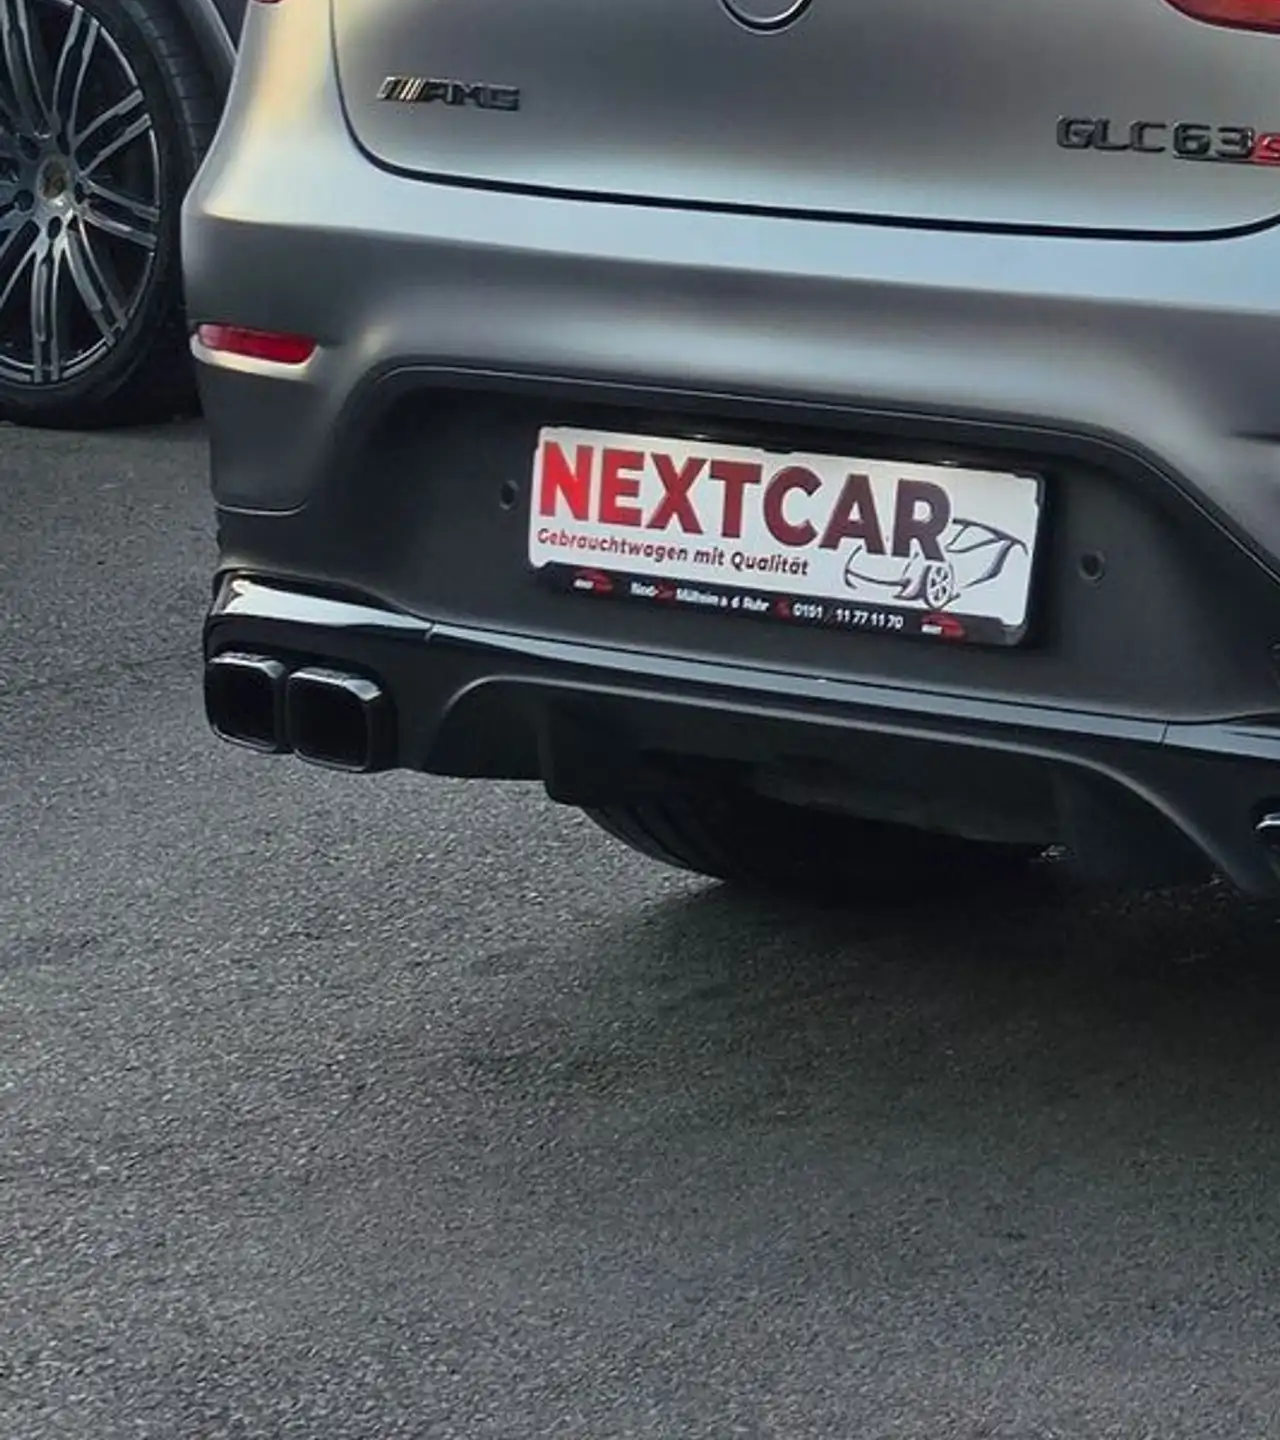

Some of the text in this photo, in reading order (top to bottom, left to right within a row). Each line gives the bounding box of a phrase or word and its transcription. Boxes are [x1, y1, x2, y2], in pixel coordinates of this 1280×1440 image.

[539, 440, 950, 560] NEXTCAR
[537, 527, 809, 576] Gebrauchtwagen mit Qualität
